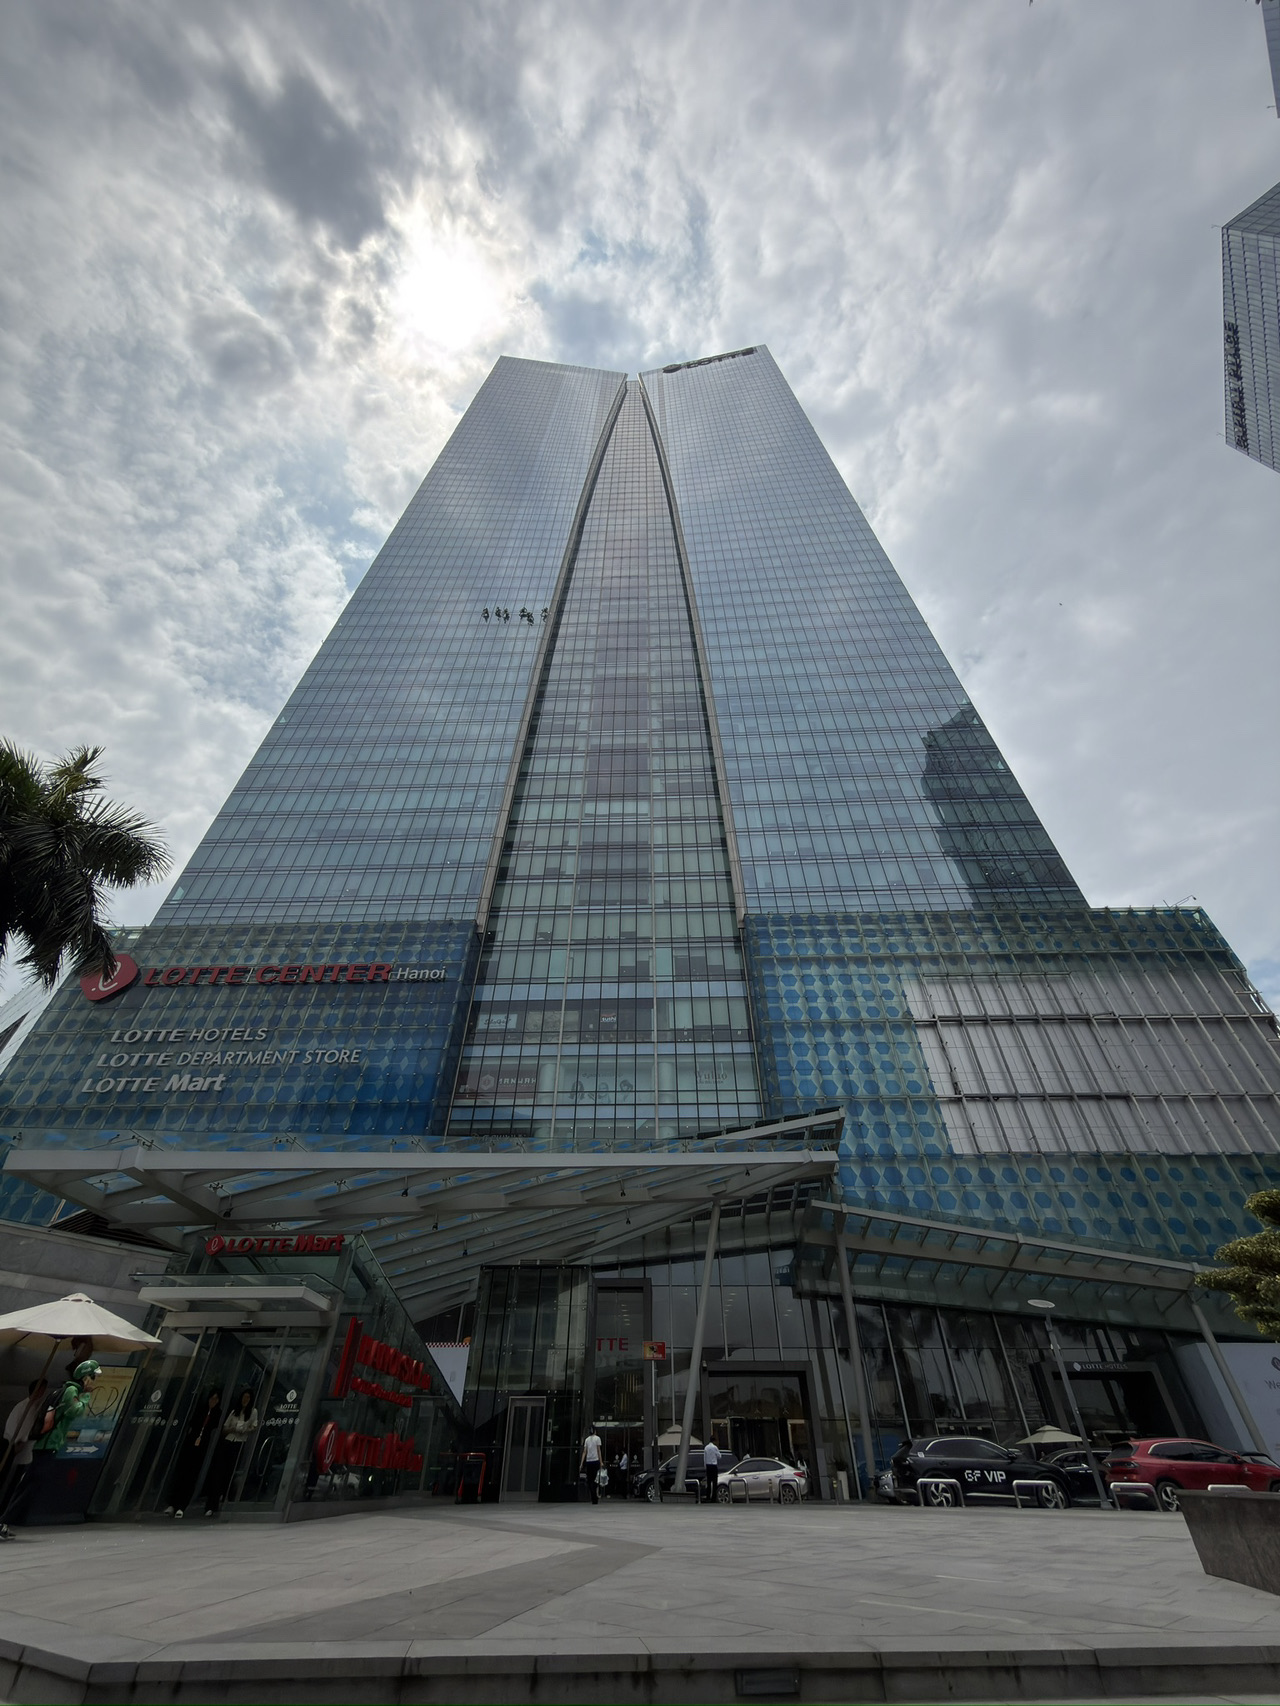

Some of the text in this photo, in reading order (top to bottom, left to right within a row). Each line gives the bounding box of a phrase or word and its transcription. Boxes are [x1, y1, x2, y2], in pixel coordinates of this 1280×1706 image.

[144, 963, 446, 986] LOTTE CENTER Hanoi
[110, 1028, 268, 1043] LOTTE HOTELS
[96, 1049, 361, 1067] LOTTE DEPARTMENT STORE
[81, 1073, 226, 1093] LOTTE Mart
[227, 1233, 345, 1253] LOTTE Mart
[964, 1469, 1007, 1483] GF VIP
